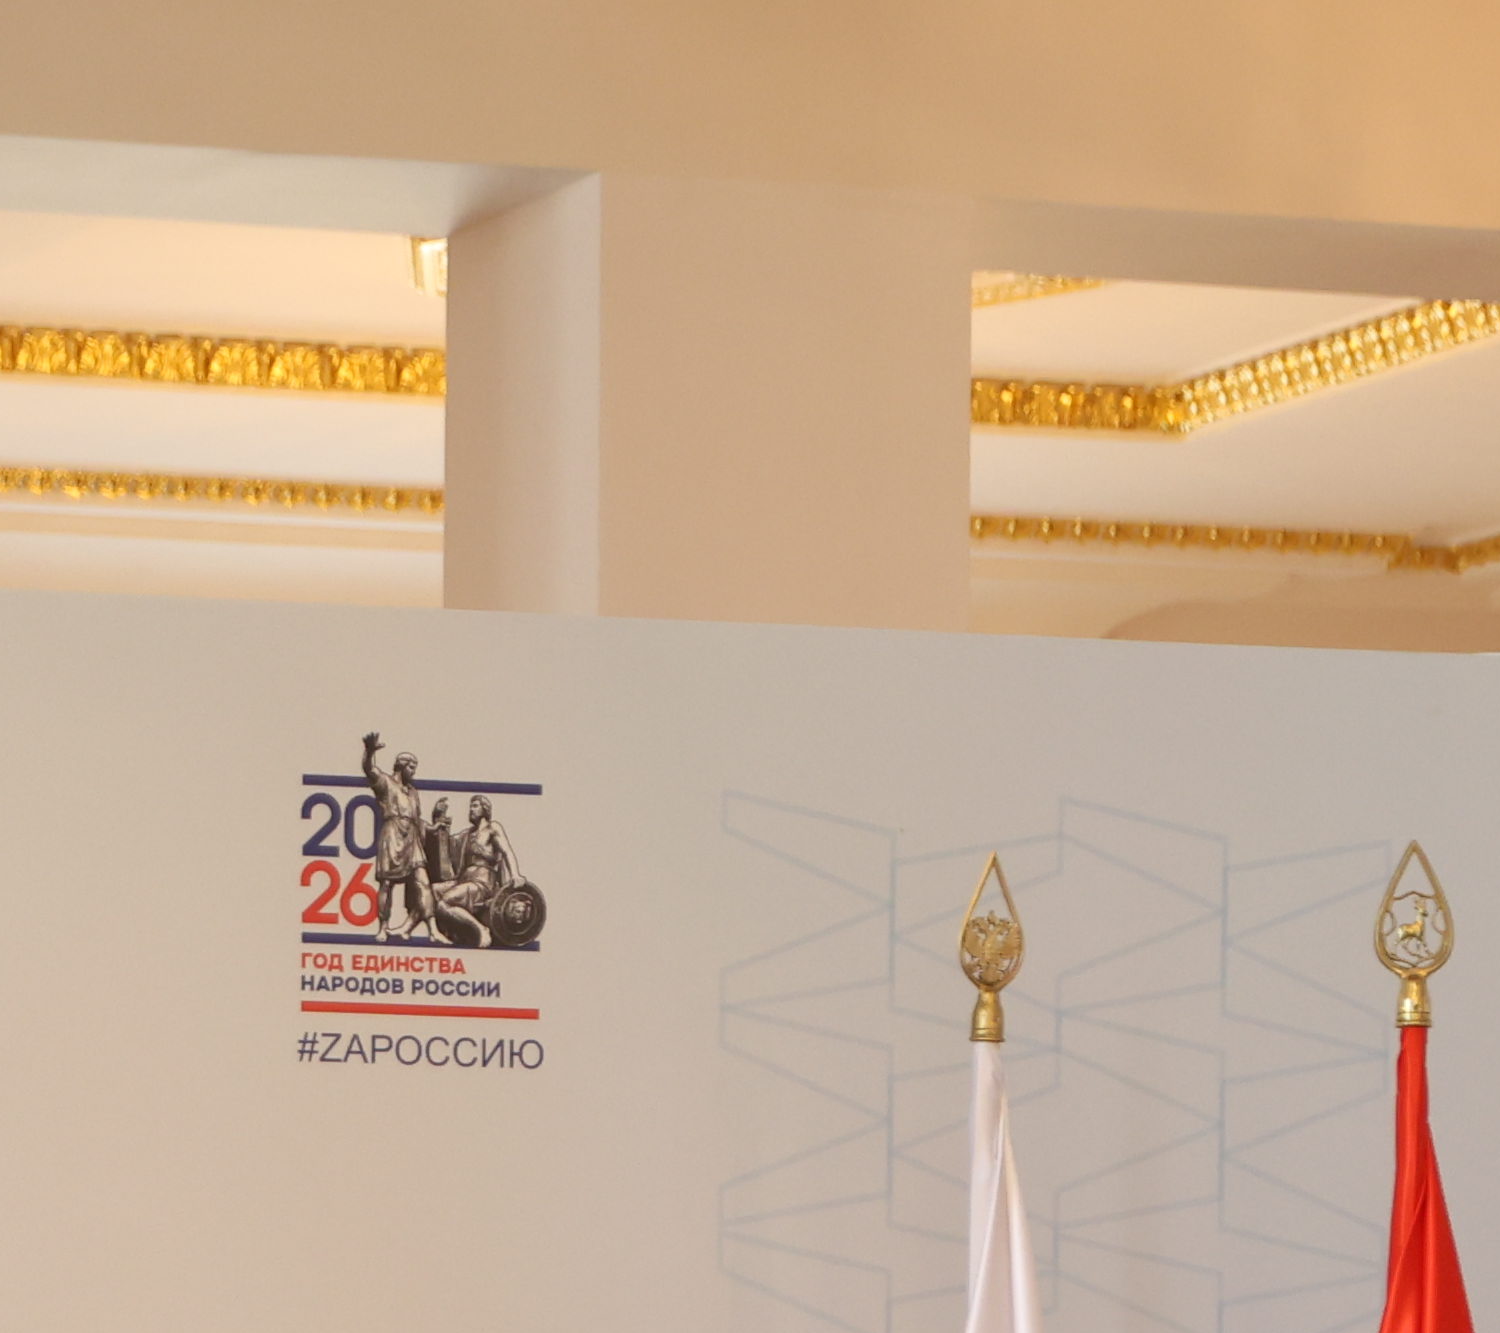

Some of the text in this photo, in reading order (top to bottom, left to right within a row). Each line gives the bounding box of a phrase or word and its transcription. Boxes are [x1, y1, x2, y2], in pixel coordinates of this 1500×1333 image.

[301, 792, 382, 860] 20
[300, 860, 379, 927] 26
[301, 952, 466, 975] ГОД ЕДИНСТВА
[301, 975, 501, 998] НАРОДОВ РОССИИ
[297, 1031, 544, 1070] #ZАРОССИЮ
